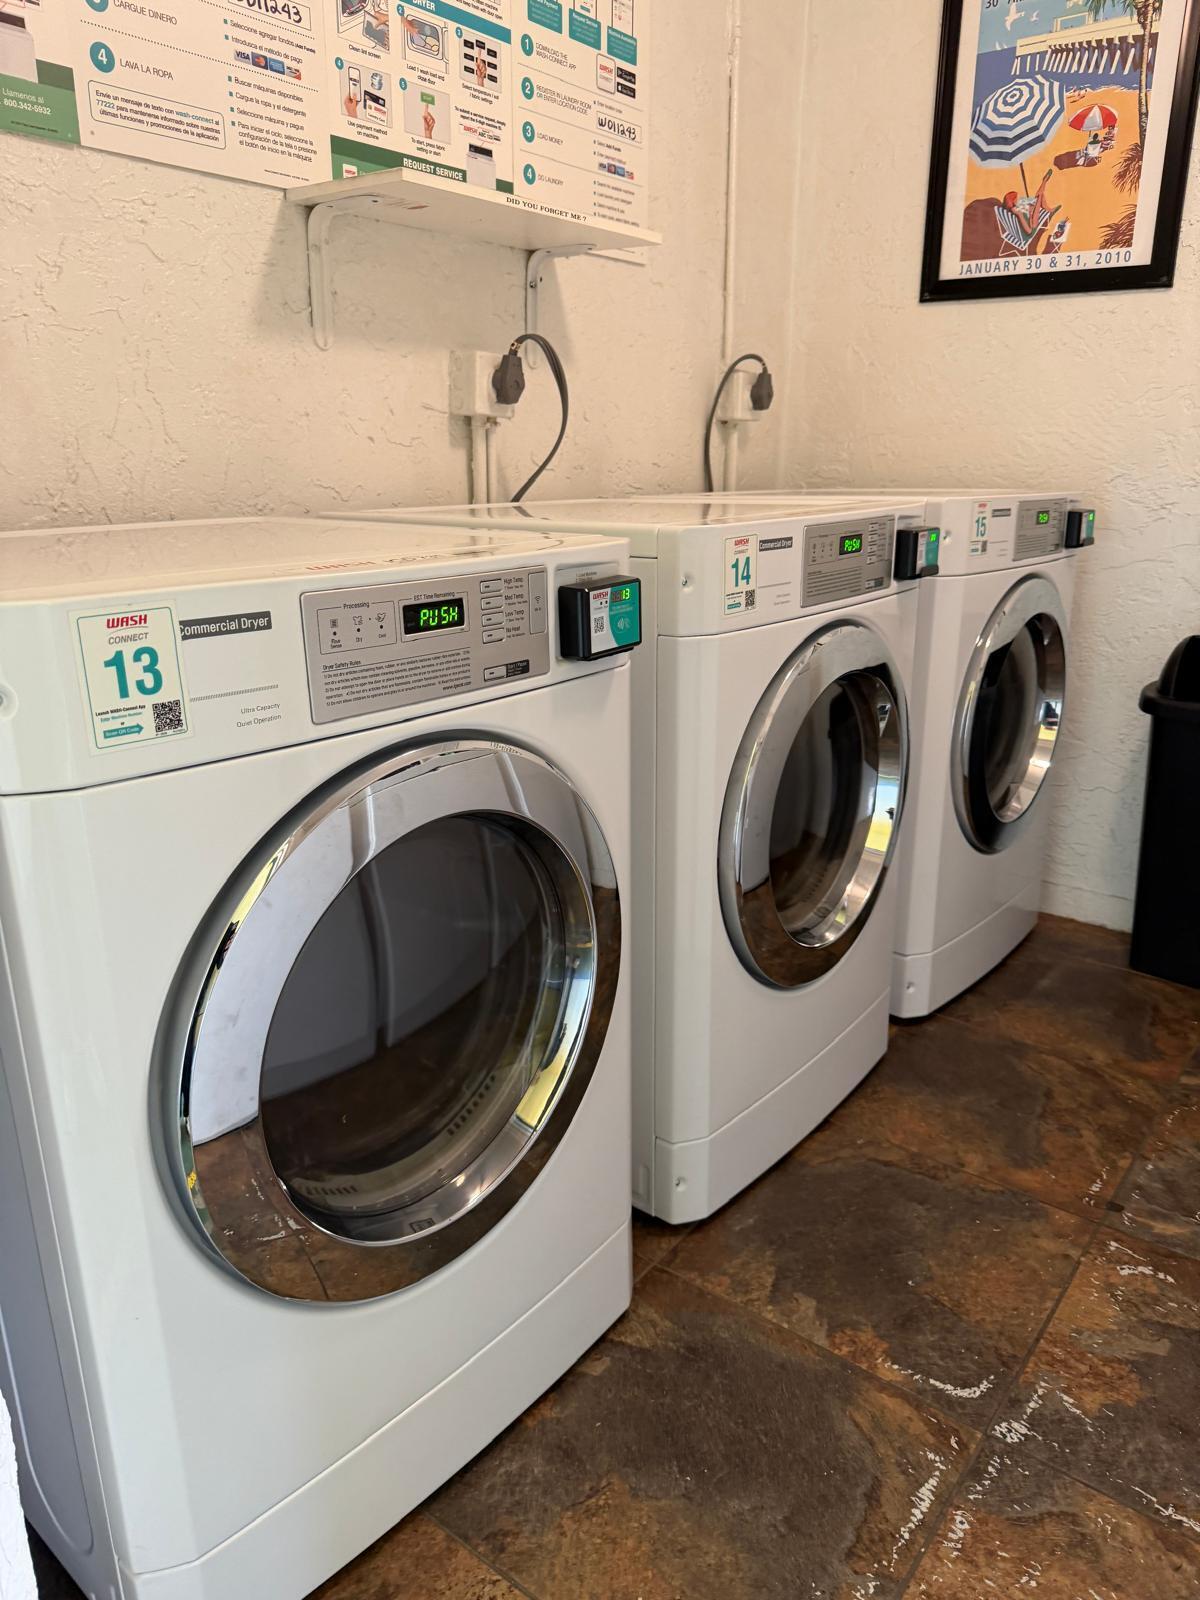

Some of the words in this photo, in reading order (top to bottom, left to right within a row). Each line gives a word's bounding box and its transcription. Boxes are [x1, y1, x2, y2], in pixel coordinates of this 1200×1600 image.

[114, 0, 147, 16] CARGUE
[148, 9, 178, 25] DINERO
[230, 20, 258, 34] Seleccione
[525, 39, 529, 50] 1
[98, 48, 108, 64] 4
[235, 50, 250, 61] VISA
[120, 58, 140, 72] LAVA
[140, 64, 151, 75] LA
[152, 68, 174, 80] ROPA
[525, 82, 530, 94] 2
[4, 98, 51, 115] 800.342-5932
[96, 98, 115, 109] 77222
[526, 125, 532, 137] 3
[598, 116, 636, 140] W011243
[403, 158, 434, 173] REQUEST
[435, 166, 463, 181] SERVICE
[526, 168, 532, 180] 4
[506, 196, 520, 206] DID
[522, 200, 539, 210] YOU
[540, 206, 568, 218] FORGET
[570, 212, 582, 221] ME
[960, 260, 1019, 276] JANUARY
[1026, 257, 1042, 270] 30
[1050, 256, 1058, 268] &
[1066, 254, 1087, 268] 31,
[1095, 250, 1132, 265] 2010
[976, 516, 987, 537] 15
[760, 540, 782, 550] Commercial
[782, 539, 792, 548] Dryer
[731, 556, 751, 588] 14
[434, 590, 455, 599] Remaining
[622, 588, 630, 600] 13
[343, 601, 370, 610] Processing
[106, 614, 148, 629] WASH
[420, 606, 458, 626] PUSH
[179, 620, 239, 637] Commercial
[241, 616, 270, 632] Dryer
[108, 632, 149, 646] CONNECT
[103, 646, 163, 699] 13
[110, 706, 138, 714] WASH-Connect
[256, 703, 280, 712] Capacity
[253, 714, 282, 725] Operation
